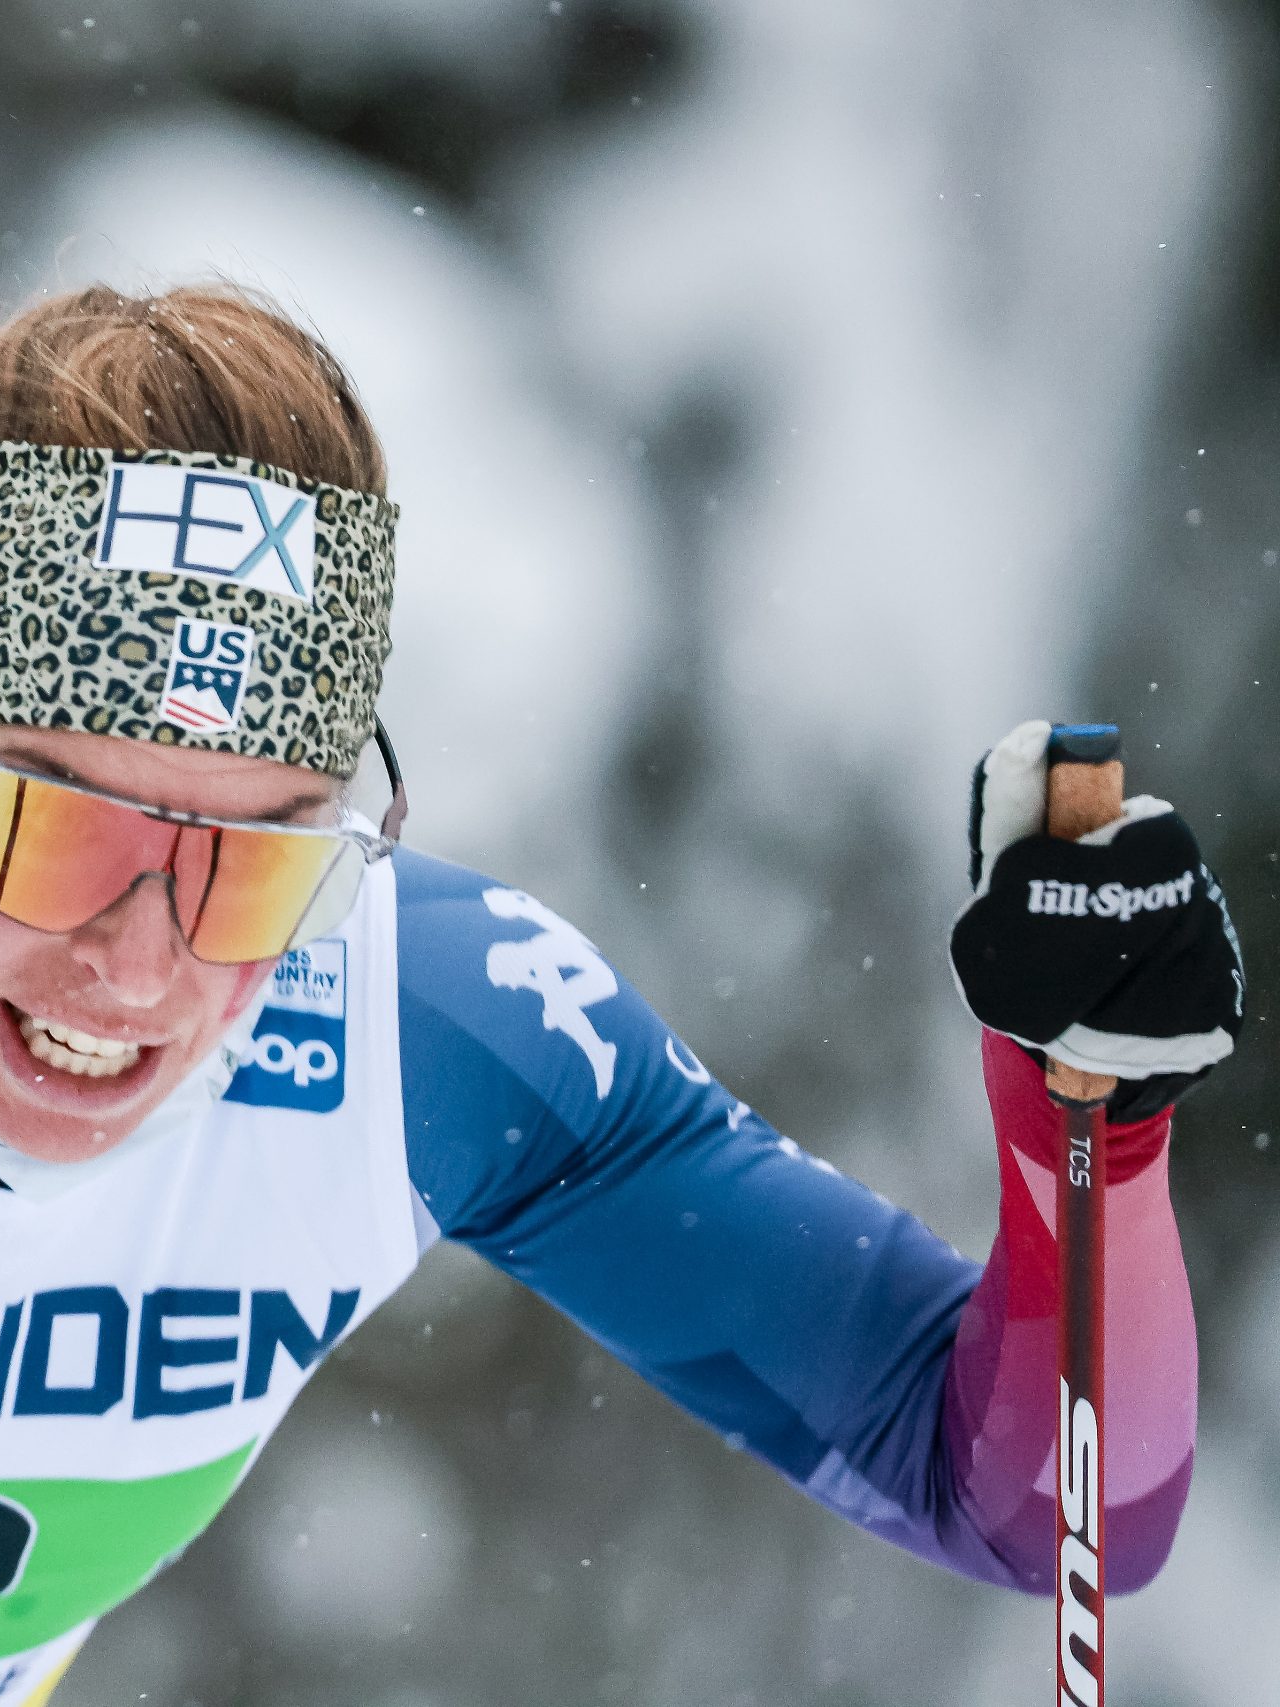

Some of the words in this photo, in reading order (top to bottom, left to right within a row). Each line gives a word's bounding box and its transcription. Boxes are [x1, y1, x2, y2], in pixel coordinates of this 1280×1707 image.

[100, 468, 309, 598] HEX
[180, 623, 247, 665] US
[1068, 1136, 1091, 1189] TCS
